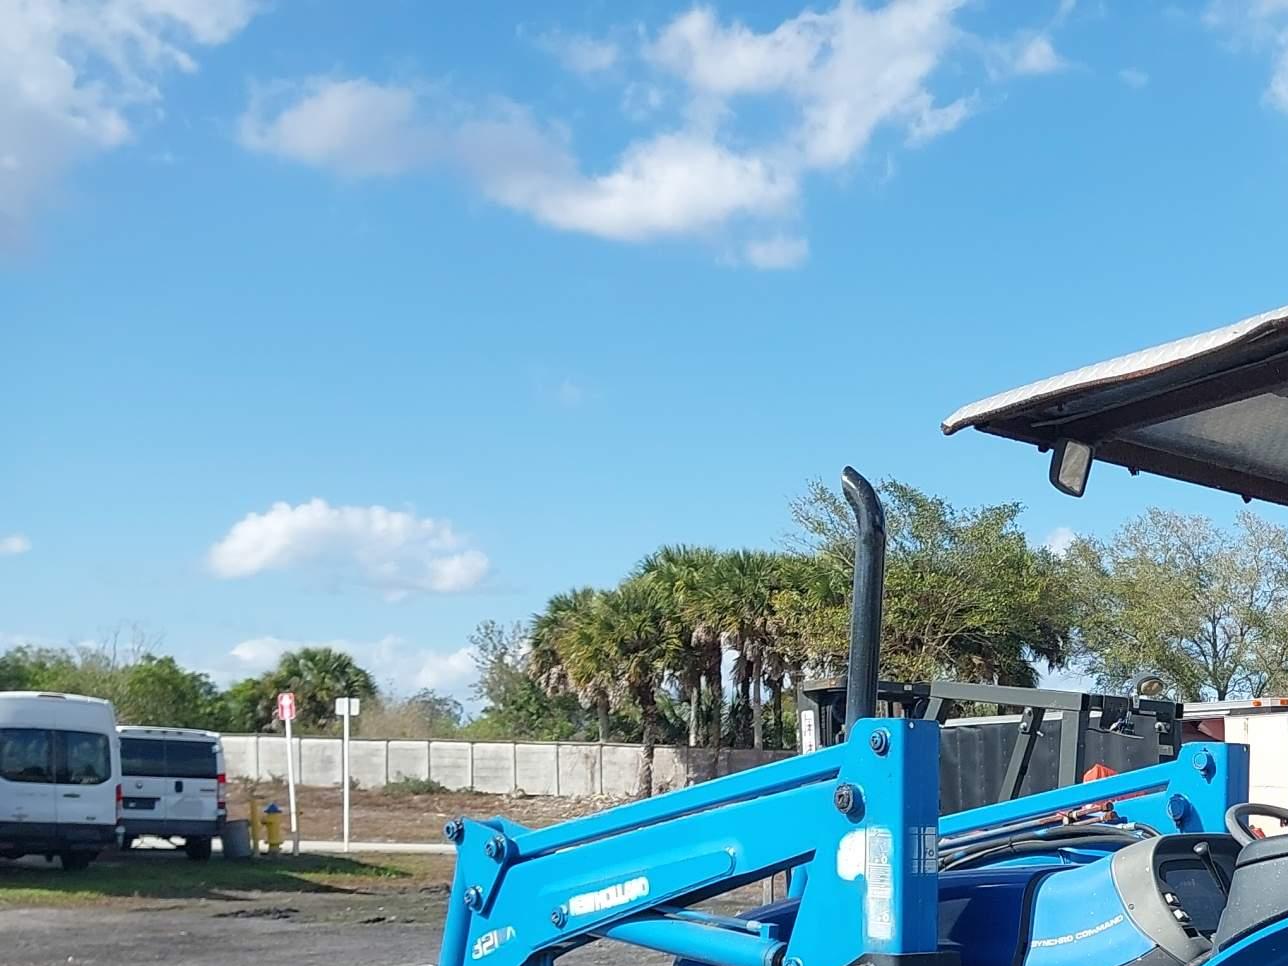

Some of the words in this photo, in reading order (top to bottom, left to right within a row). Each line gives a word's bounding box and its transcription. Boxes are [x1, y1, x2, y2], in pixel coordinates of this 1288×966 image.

[595, 876, 650, 912] HOLLAND
[1031, 934, 1074, 948] SYNCHRO
[1075, 914, 1124, 940] COMMAND
